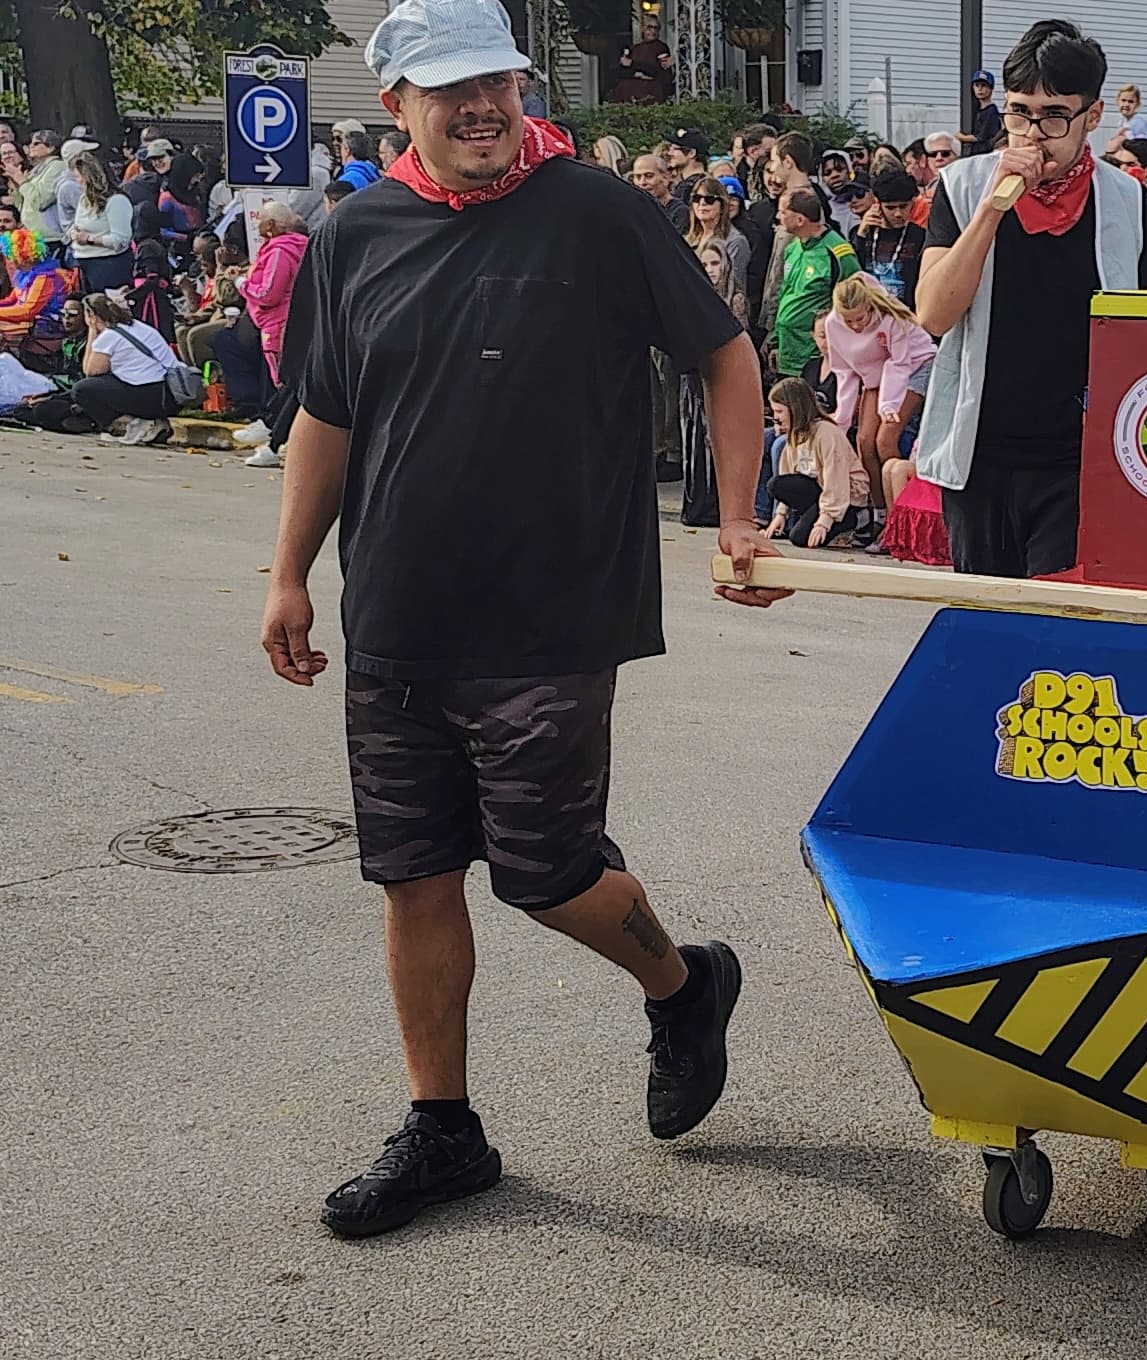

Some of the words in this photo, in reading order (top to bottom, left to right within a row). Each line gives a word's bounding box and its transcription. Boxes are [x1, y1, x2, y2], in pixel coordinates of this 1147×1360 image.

[229, 58, 255, 73] FOREST
[279, 61, 305, 76] PARK
[254, 96, 287, 142] P
[1033, 672, 1120, 716] D91
